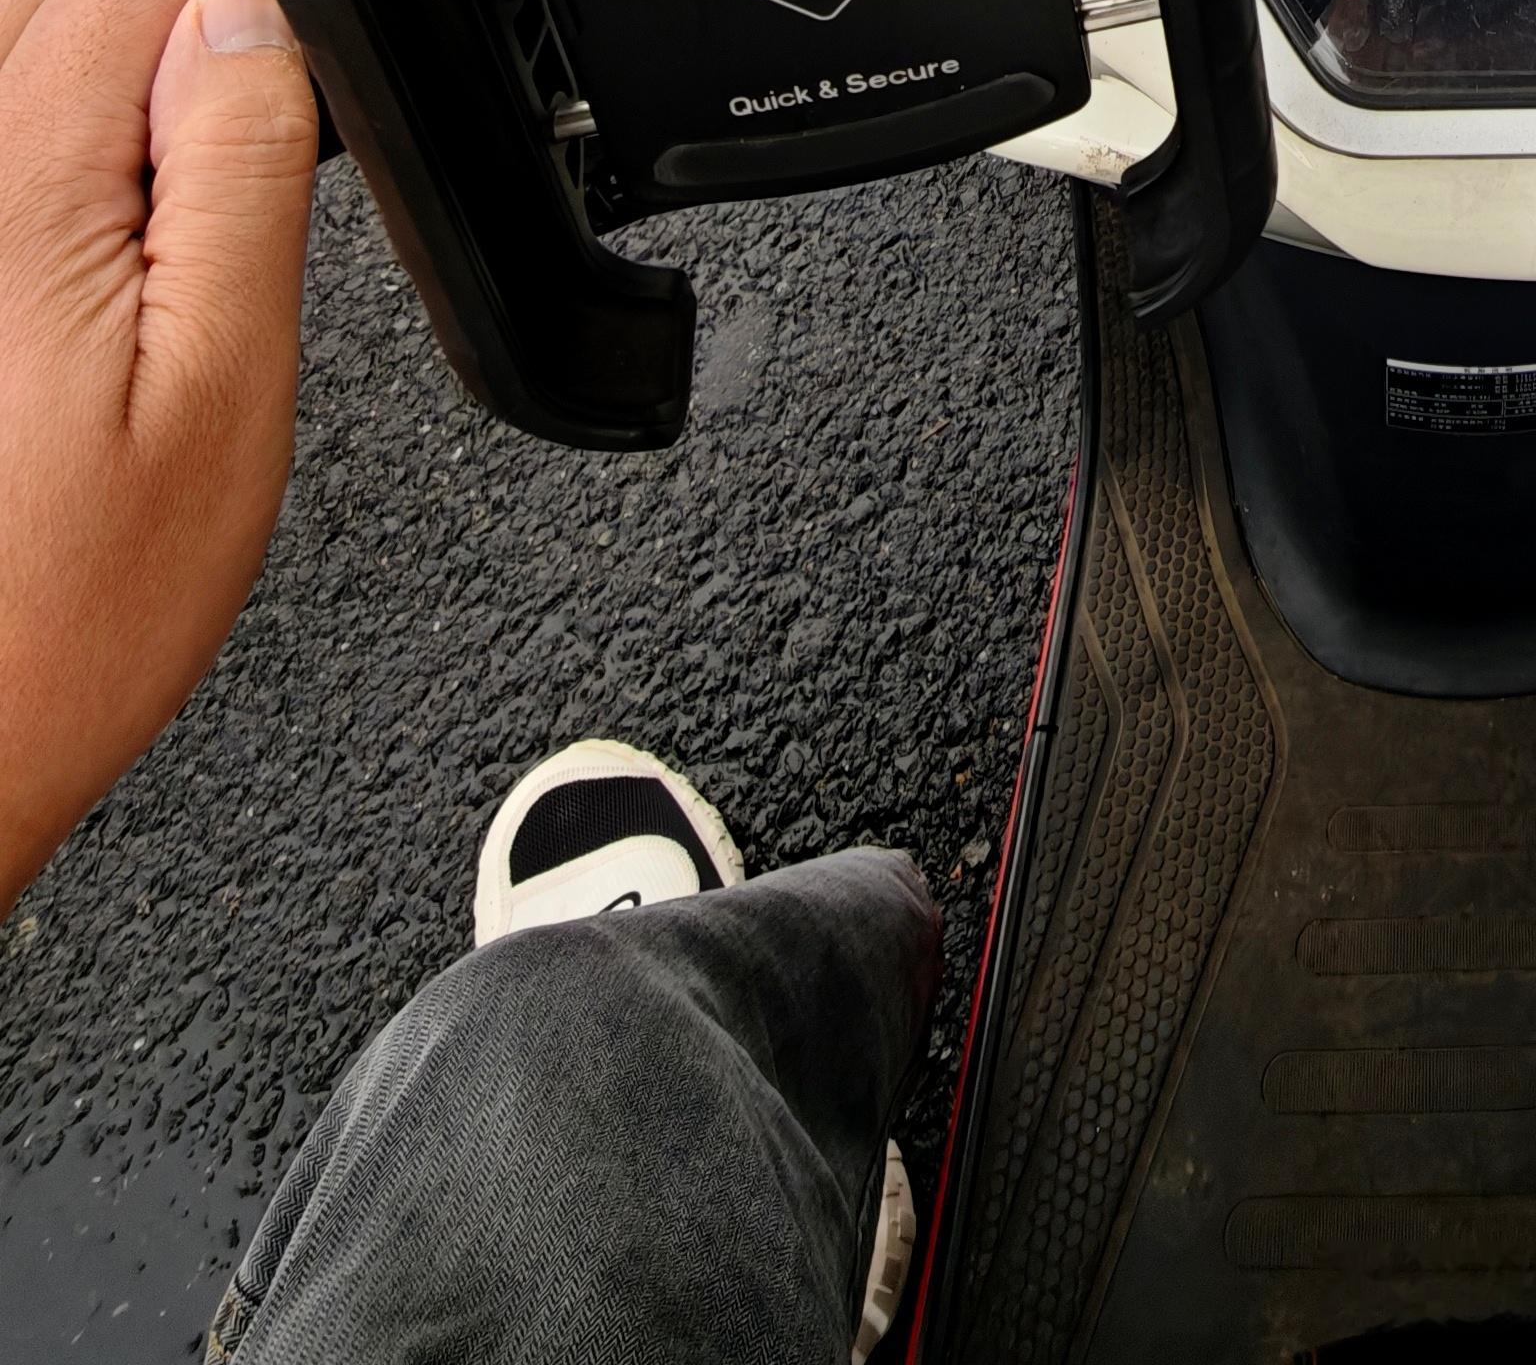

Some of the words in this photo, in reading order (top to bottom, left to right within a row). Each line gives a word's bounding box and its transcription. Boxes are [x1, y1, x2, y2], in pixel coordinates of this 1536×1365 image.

[728, 85, 813, 117] Quick
[818, 79, 839, 100] &
[846, 58, 960, 94] Secure
